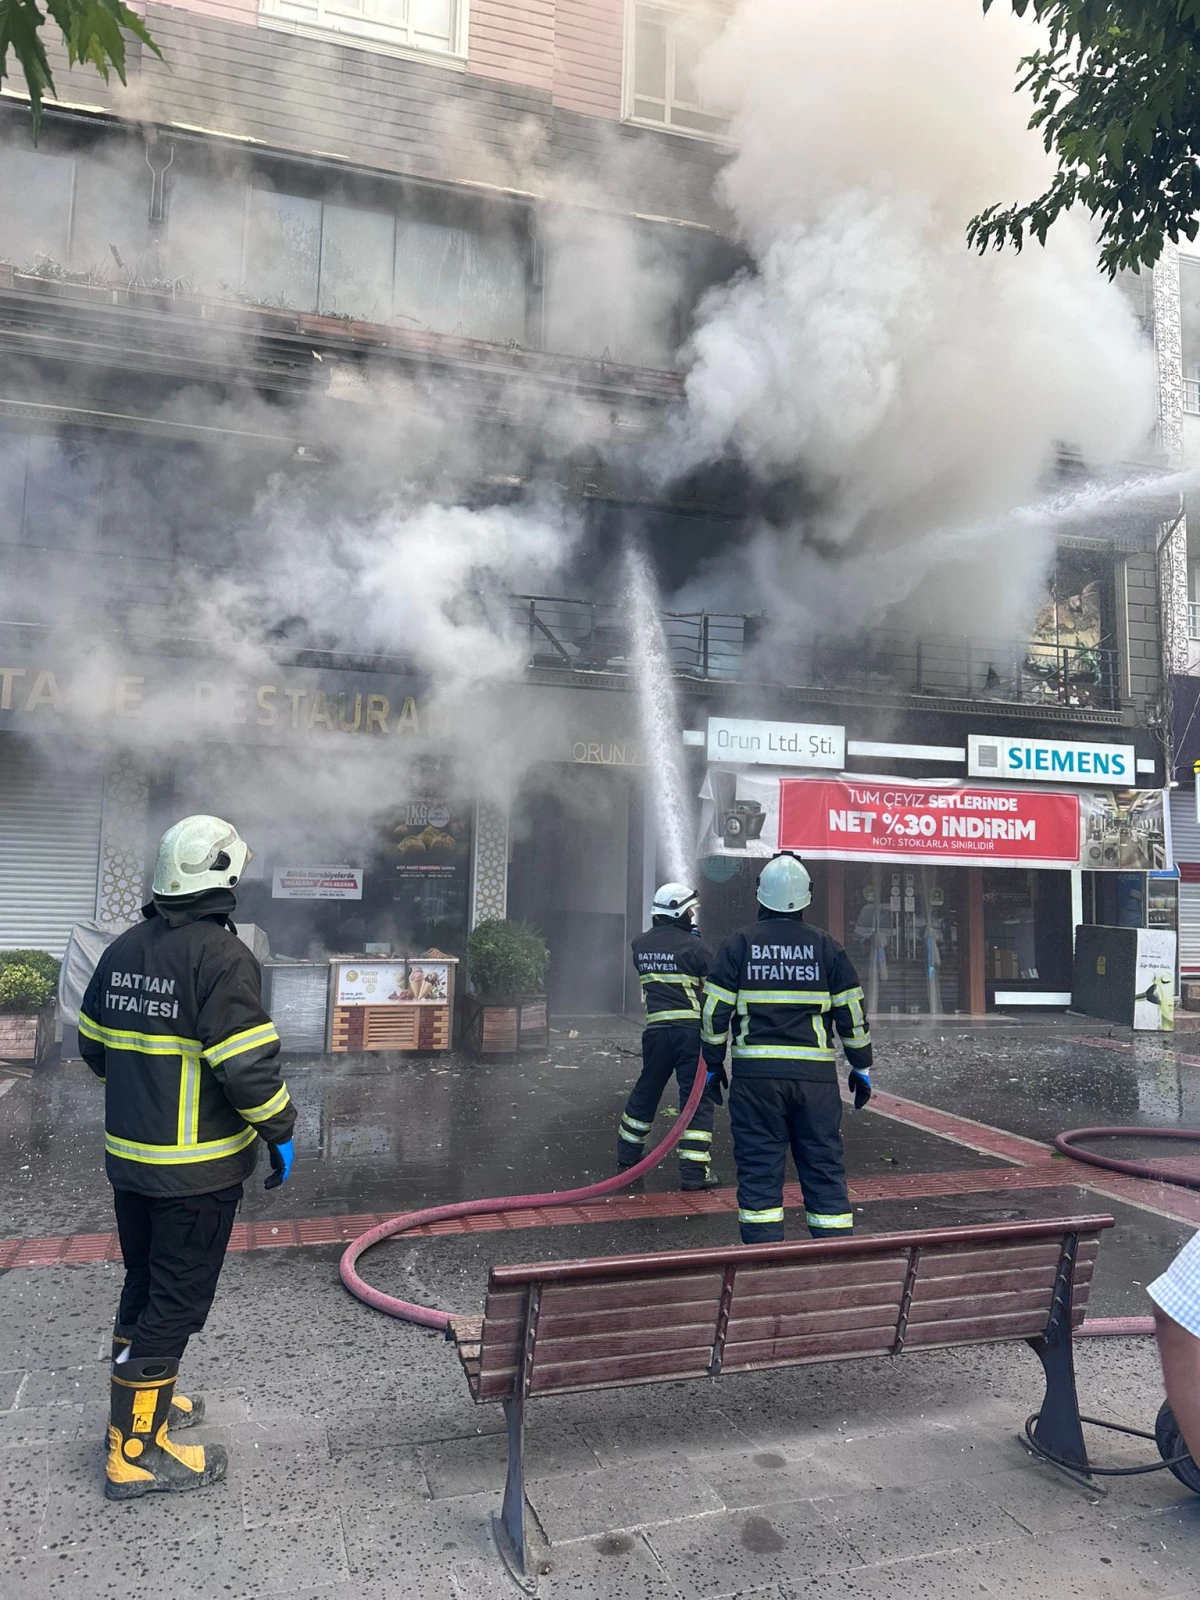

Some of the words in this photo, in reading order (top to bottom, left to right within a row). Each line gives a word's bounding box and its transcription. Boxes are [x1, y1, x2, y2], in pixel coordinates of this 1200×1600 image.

[572, 741, 626, 763] ORUN
[717, 729, 760, 750] Orun
[768, 732, 802, 752] Ltd.
[808, 735, 836, 757] Şti.
[1008, 746, 1126, 776] SIEMENS
[829, 809, 877, 834] NET
[882, 812, 937, 837] %30
[872, 836, 895, 847] NOT:
[898, 837, 949, 849] STOKLARLA
[638, 952, 675, 961] BATMAN
[751, 944, 814, 960] BATMAN
[747, 962, 820, 981] İTFAİYESİ
[111, 971, 176, 995] BATMAN
